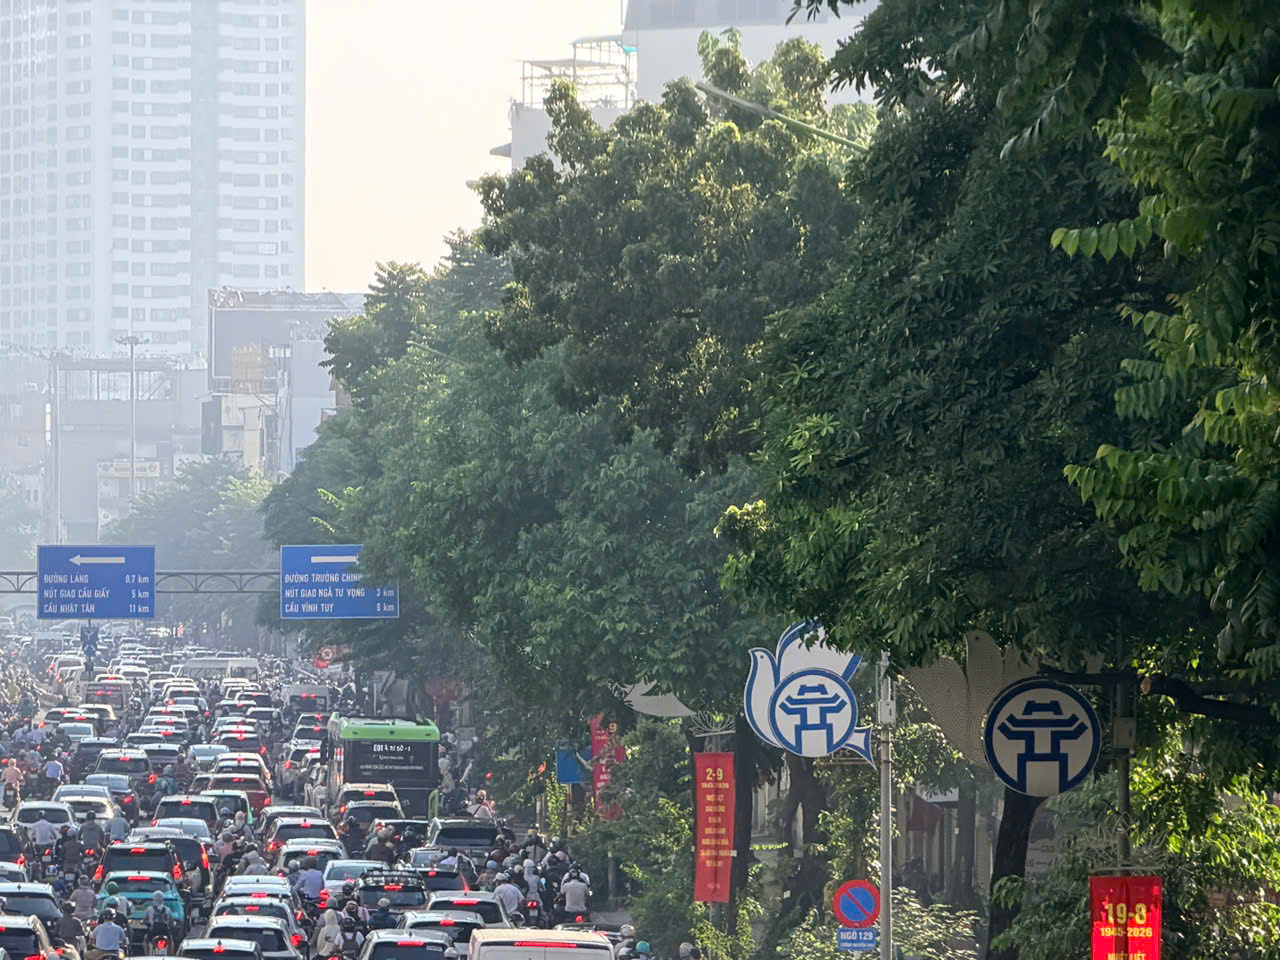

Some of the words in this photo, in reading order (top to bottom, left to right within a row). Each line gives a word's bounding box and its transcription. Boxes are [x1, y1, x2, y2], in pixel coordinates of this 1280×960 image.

[125, 575, 136, 583] 0.7
[138, 574, 149, 583] km
[60, 590, 75, 598] GIAO
[131, 590, 136, 598] 5
[138, 590, 149, 598] km
[300, 589, 316, 597] GIAO
[376, 588, 380, 597] 3
[383, 588, 394, 597] km
[129, 604, 136, 613] 11
[138, 604, 149, 613] km
[383, 603, 394, 612] km
[706, 768, 723, 780] 2-9
[1107, 903, 1147, 925] 19-8
[859, 932, 873, 940] 129
[1100, 927, 1153, 937] 1945-2026
